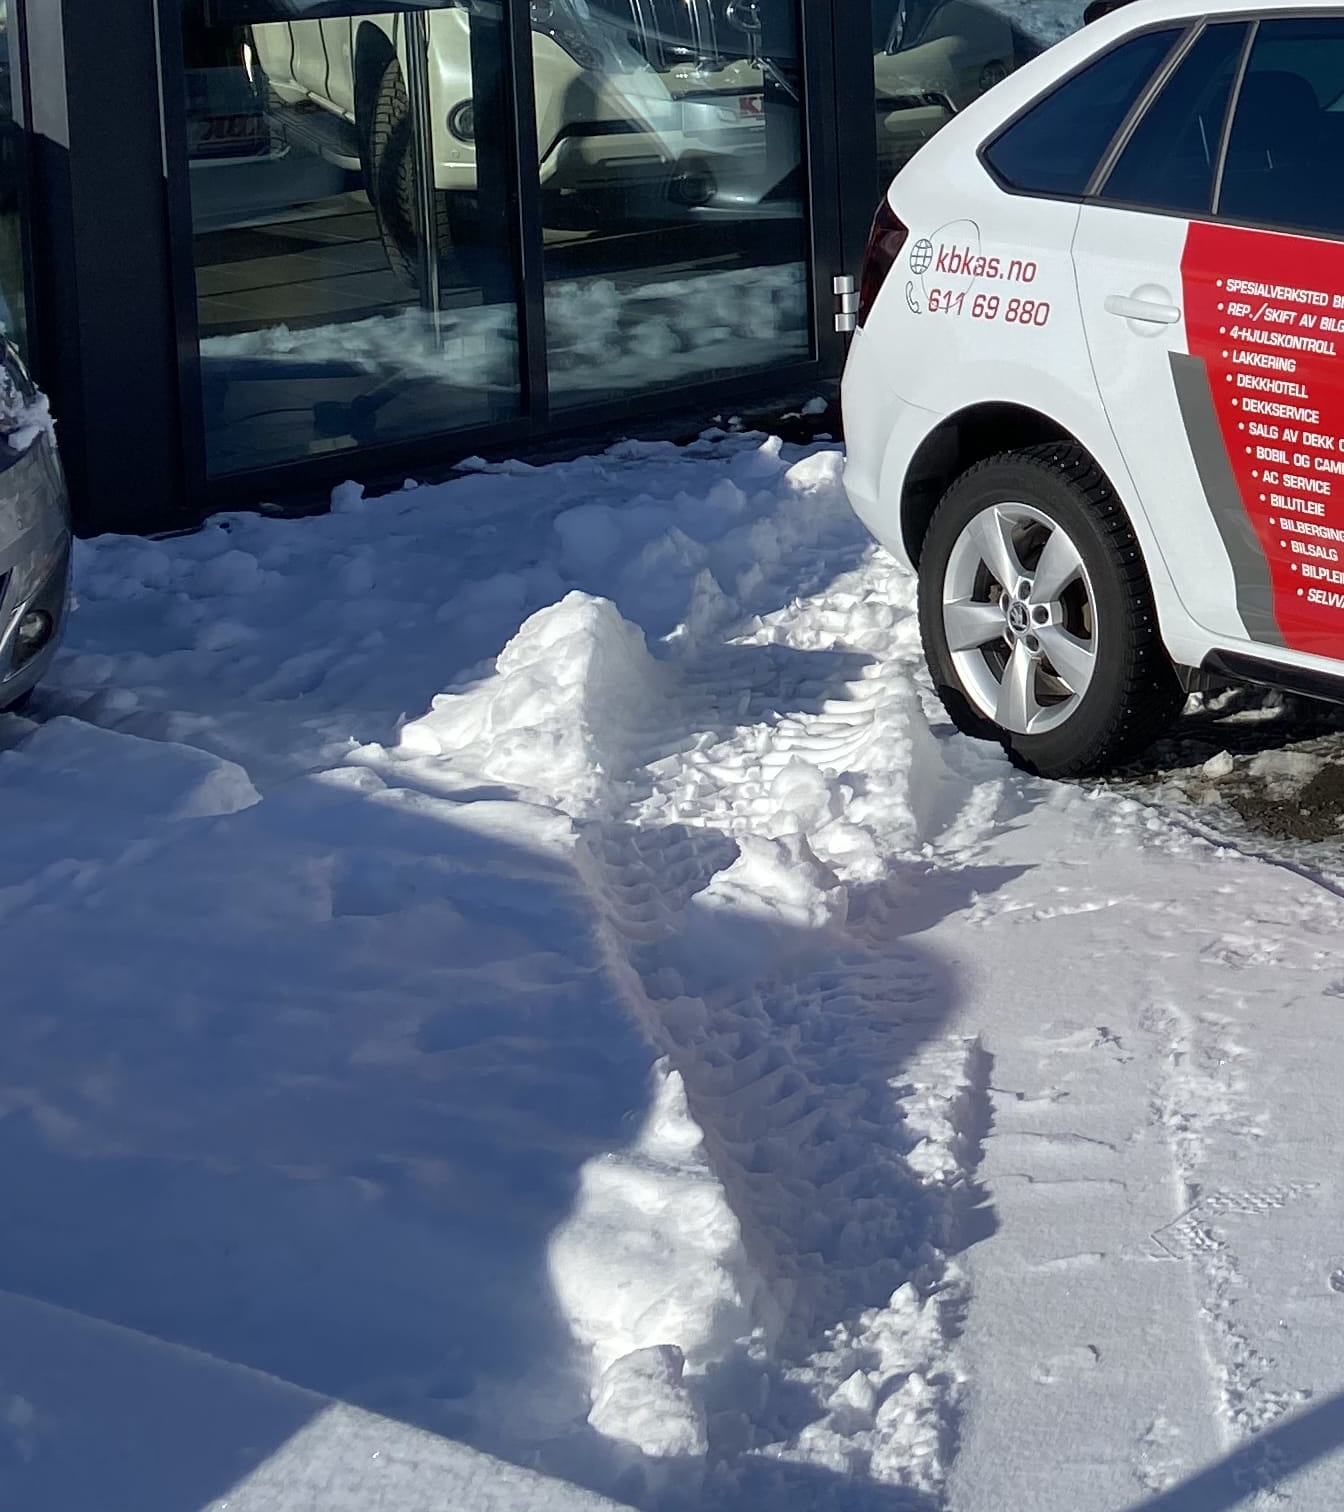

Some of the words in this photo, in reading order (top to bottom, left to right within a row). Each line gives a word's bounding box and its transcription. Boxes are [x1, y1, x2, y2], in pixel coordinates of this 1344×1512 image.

[936, 244, 1037, 283] kbkas.no
[1226, 278, 1329, 305] SPESIALVERKSTED
[928, 289, 966, 316] 611
[972, 294, 1000, 320] 69
[1005, 299, 1050, 326] 880
[1227, 302, 1297, 326] REP./SKIFT
[1299, 312, 1316, 328] AV
[1229, 326, 1337, 356] 4-HJULSKONTROLL
[1232, 349, 1297, 373] LAKKERING
[1236, 373, 1309, 399] DEKKHOTELL
[1242, 397, 1320, 424] DEKKSERVICE
[1248, 422, 1279, 440] SALG
[1282, 427, 1299, 443] AV
[1302, 432, 1335, 450] DEKK
[1256, 445, 1290, 465] BOBIL
[1293, 453, 1310, 468] OG
[1262, 470, 1280, 485] AC
[1282, 476, 1331, 496] SERVICE
[1270, 493, 1326, 517] BILUTLEIE
[1290, 540, 1339, 562] BILSALG
